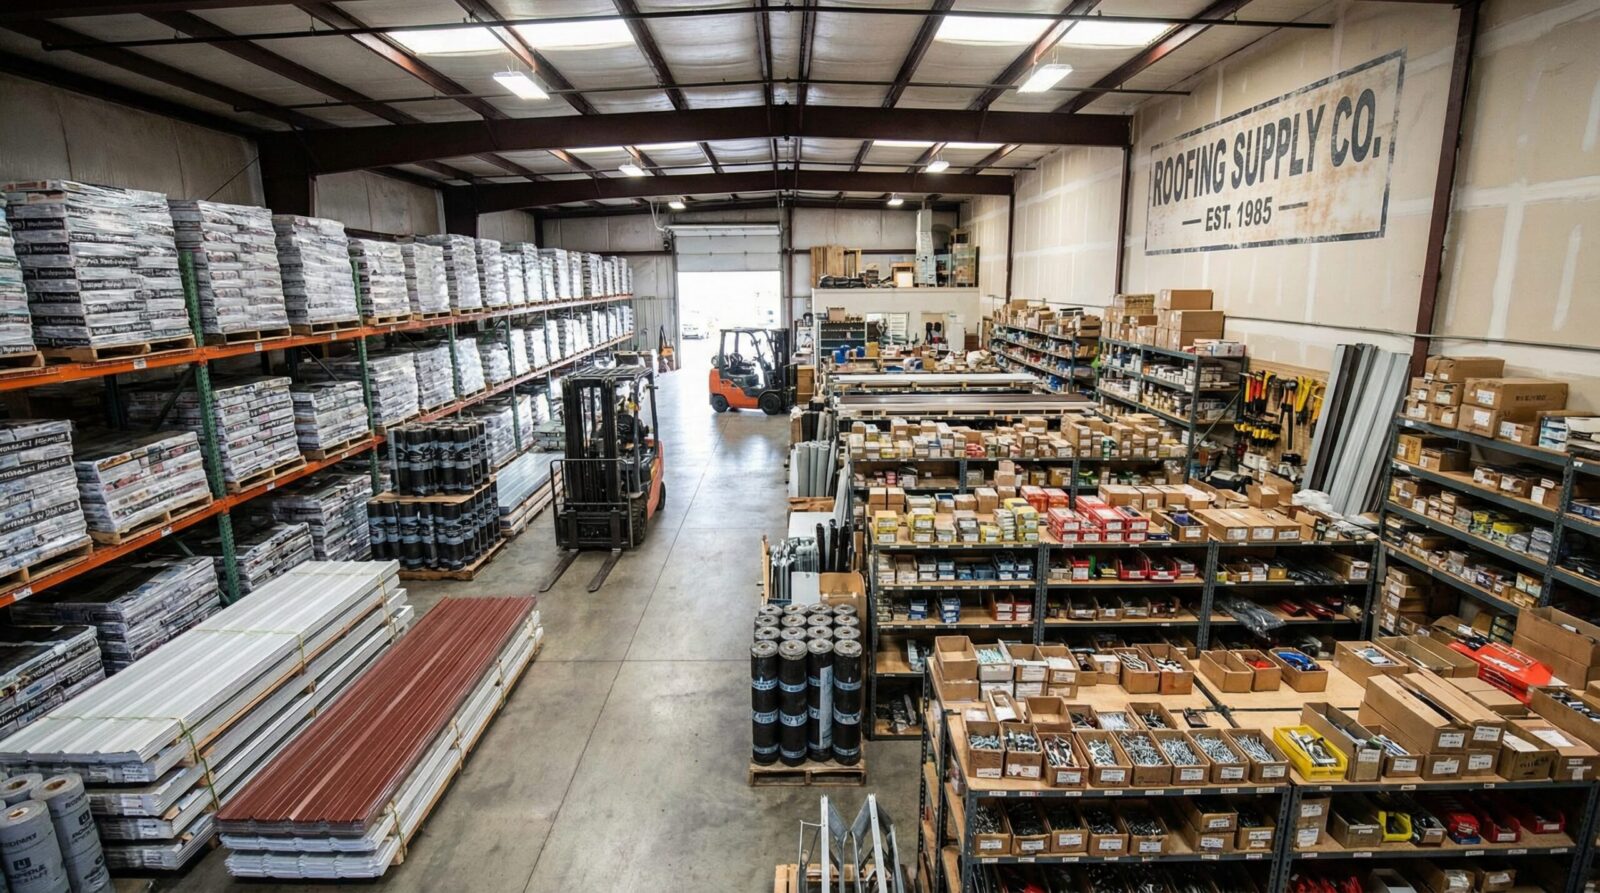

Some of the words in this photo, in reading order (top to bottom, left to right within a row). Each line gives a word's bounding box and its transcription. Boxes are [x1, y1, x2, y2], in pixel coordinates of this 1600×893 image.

[1153, 138, 1226, 207] ROOFING
[1231, 104, 1326, 190] SUPPLY
[1331, 88, 1381, 168] CO.
[1205, 204, 1231, 232] EST.
[1237, 196, 1273, 227] 1985
